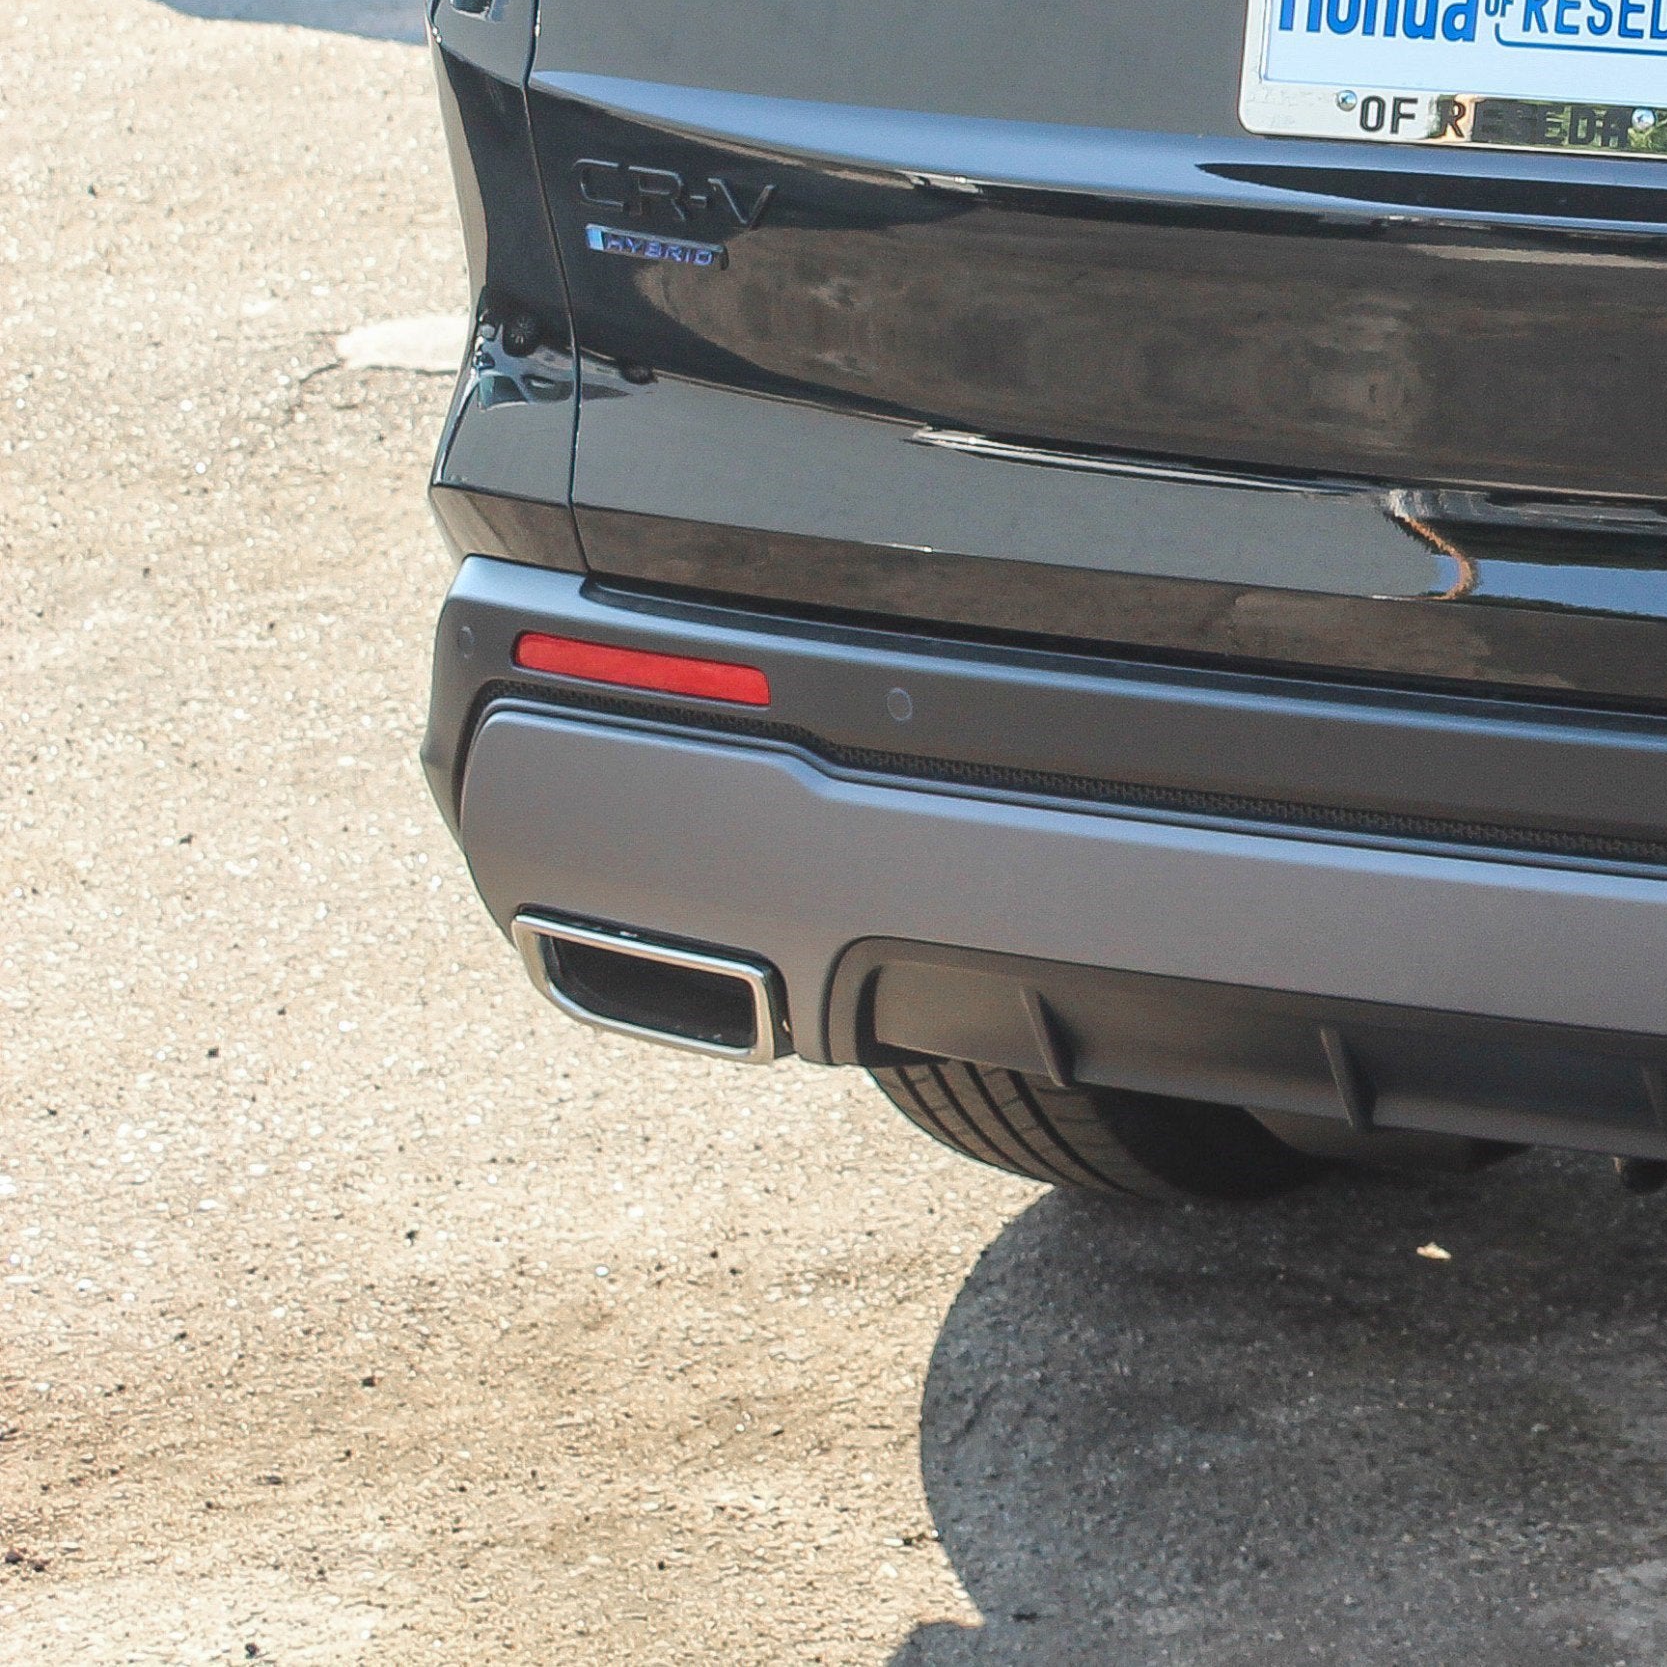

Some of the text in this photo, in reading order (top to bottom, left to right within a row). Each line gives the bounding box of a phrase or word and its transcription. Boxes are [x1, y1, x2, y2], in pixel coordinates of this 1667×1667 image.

[1358, 95, 1420, 136] OF
[573, 158, 777, 228] CR-V
[605, 233, 714, 267] HYBRID
